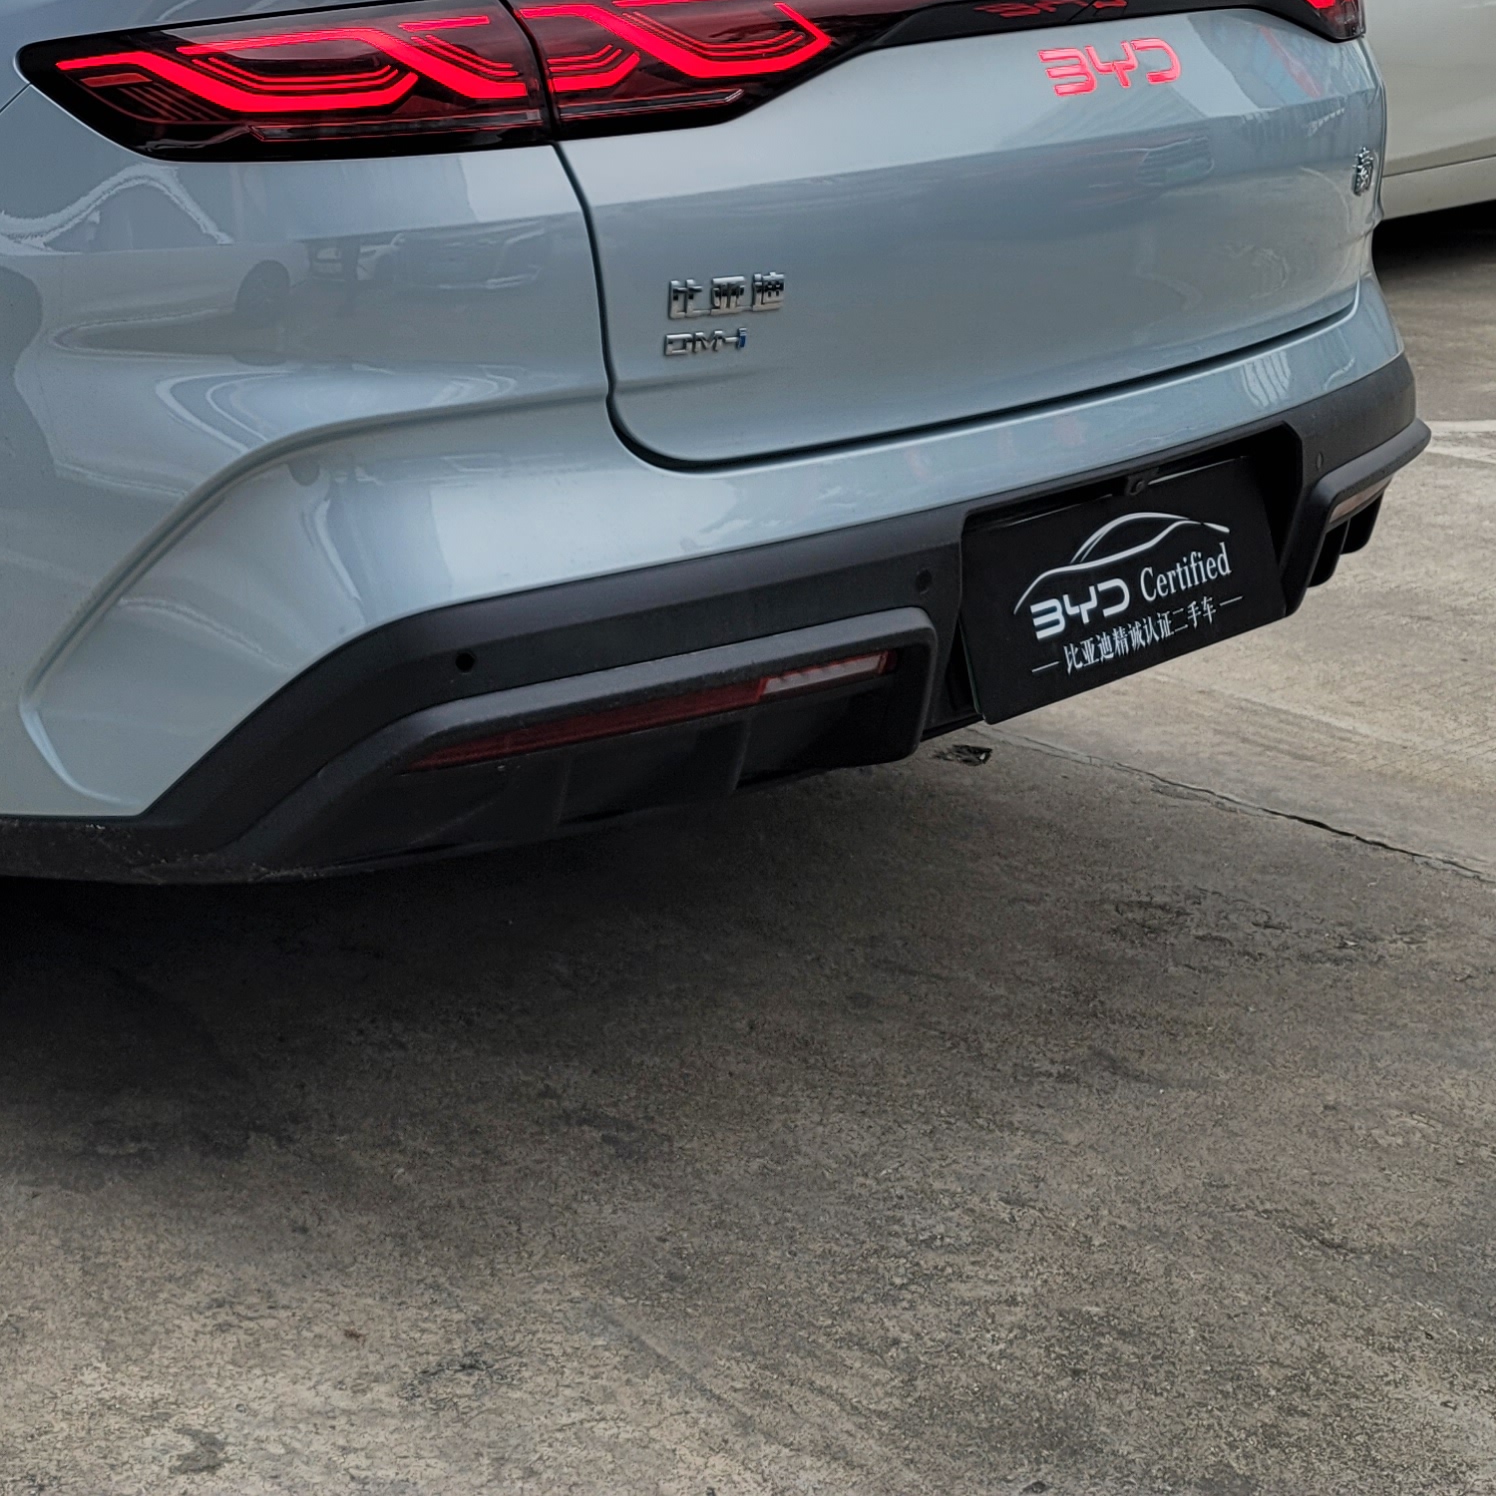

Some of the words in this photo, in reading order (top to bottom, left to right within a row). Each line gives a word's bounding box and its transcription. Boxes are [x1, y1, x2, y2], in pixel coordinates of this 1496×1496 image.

[1037, 37, 1182, 97] BYD
[668, 272, 785, 320] 比亚迪
[1029, 577, 1131, 641] BYD
[1139, 542, 1232, 603] Certified
[1063, 595, 1217, 675] 比亚迪精诚认证二手车
